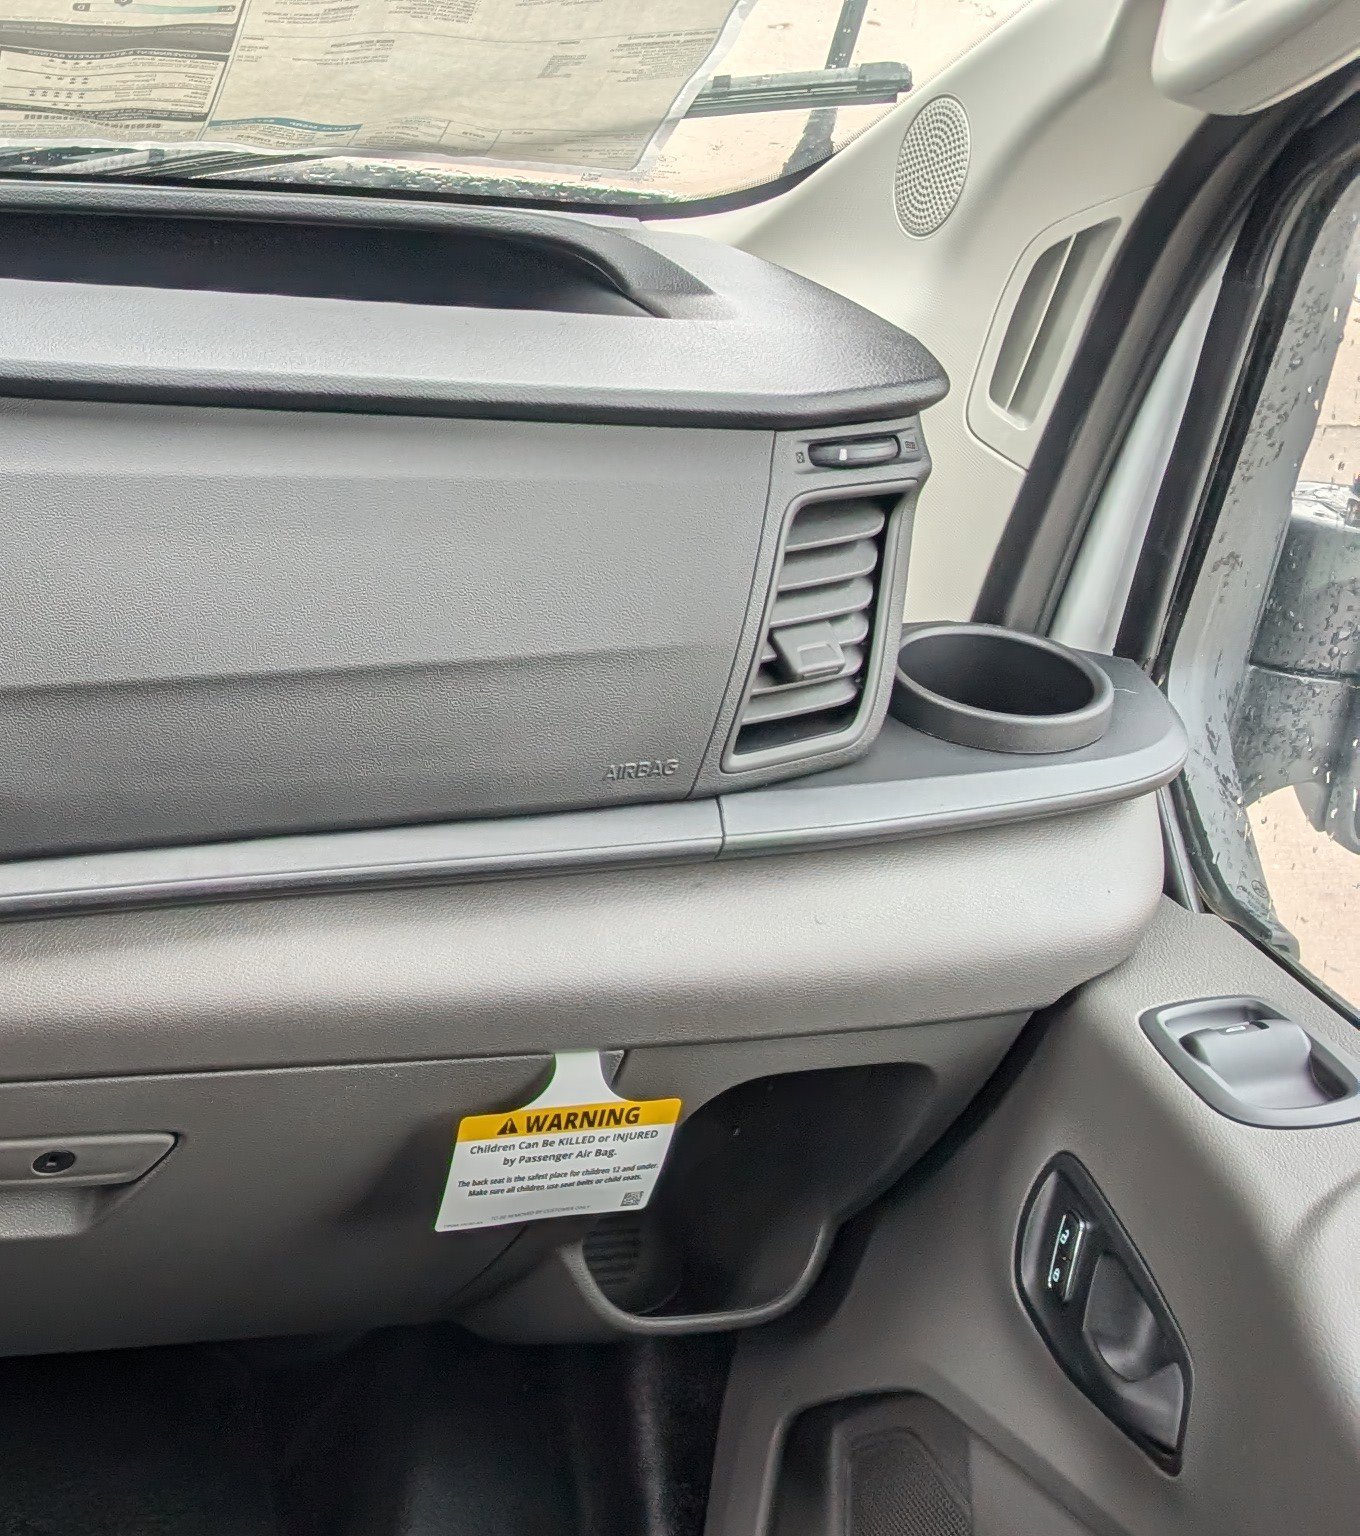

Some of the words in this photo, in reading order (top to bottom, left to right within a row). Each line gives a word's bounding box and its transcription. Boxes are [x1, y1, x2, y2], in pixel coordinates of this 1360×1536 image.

[601, 758, 679, 781] AIRBAG
[525, 1106, 641, 1134] WARNING
[469, 1142, 516, 1155] Children
[518, 1140, 539, 1151] Can
[542, 1138, 556, 1148] Be
[557, 1134, 595, 1147] KILLED
[597, 1134, 611, 1144] or
[612, 1129, 659, 1142] INJURED
[502, 1155, 516, 1168] by
[518, 1150, 574, 1164] Passenger
[575, 1148, 593, 1159] Air
[595, 1146, 618, 1159] Bag.
[458, 1180, 471, 1188] The
[472, 1178, 488, 1187] back
[489, 1177, 505, 1185] seat
[527, 1172, 549, 1181] safest
[549, 1171, 569, 1180] place
[569, 1170, 581, 1178] for
[581, 1167, 611, 1176] children
[621, 1164, 636, 1173] and
[636, 1162, 659, 1171] under.
[468, 1189, 488, 1197] Make
[506, 1186, 516, 1194] all
[516, 1183, 545, 1193] children
[560, 1181, 576, 1189] seat
[576, 1178, 594, 1187] belts
[603, 1175, 622, 1184] child
